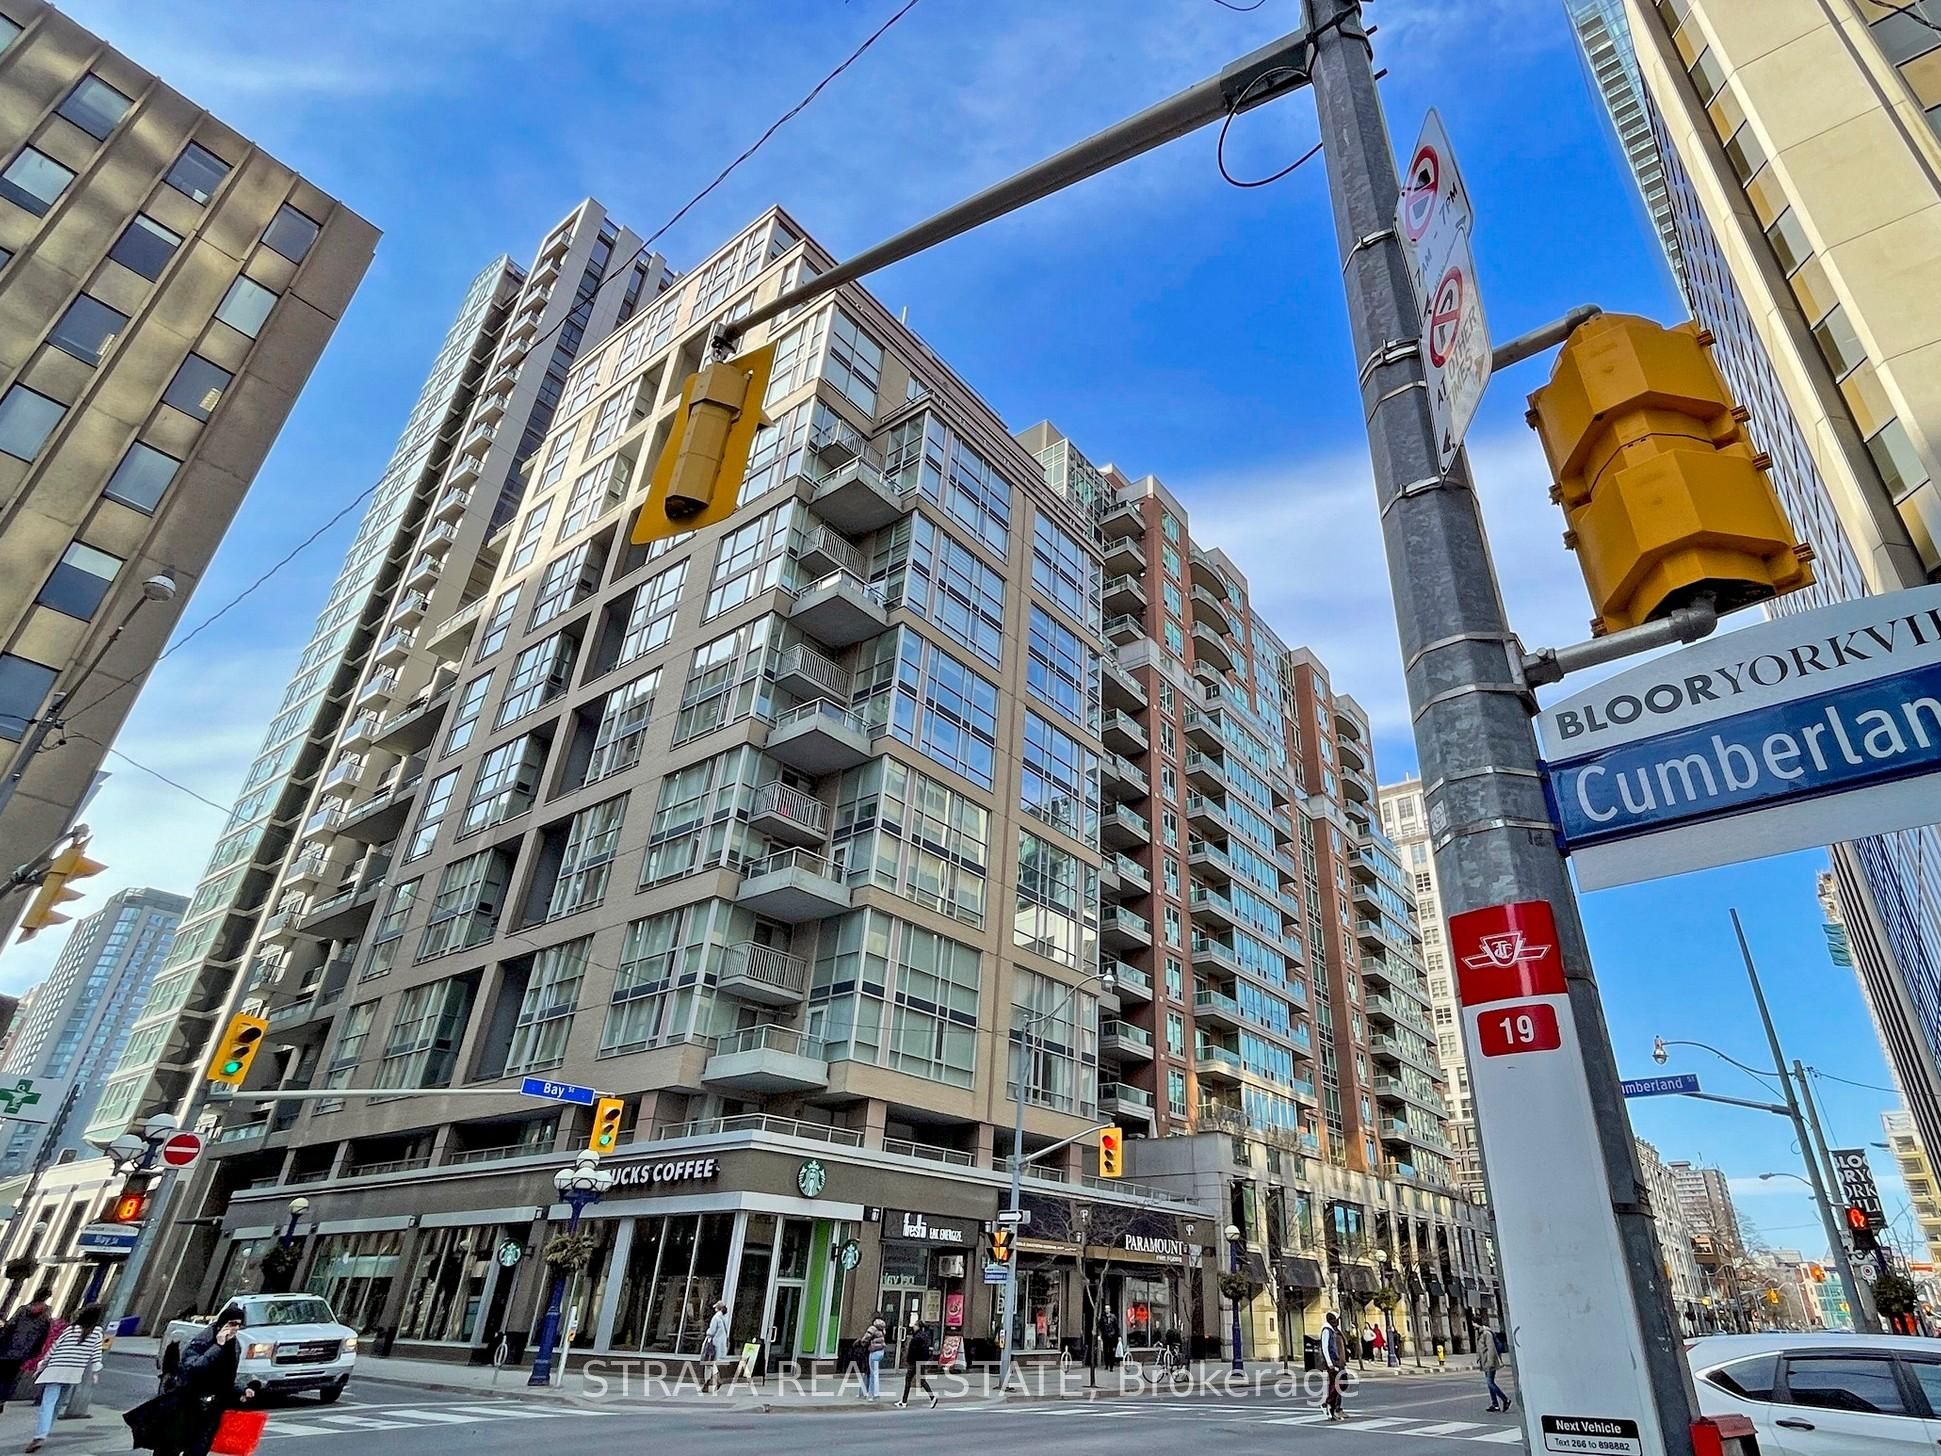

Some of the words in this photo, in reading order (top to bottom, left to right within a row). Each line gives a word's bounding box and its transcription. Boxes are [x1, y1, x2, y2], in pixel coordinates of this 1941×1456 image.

[1437, 375, 1447, 410] AT
[1448, 305, 1478, 378] OTHER
[1446, 349, 1474, 410] TIMES
[1499, 1014, 1535, 1045] 19
[543, 1082, 565, 1098] Bay
[611, 1165, 650, 1186] UCKS
[652, 1158, 715, 1182] COFFEE
[1125, 1233, 1184, 1256] PARAMOUNT
[1555, 1419, 1580, 1431] Next
[1581, 1421, 1622, 1434] Vehicle
[1554, 1438, 1570, 1447] Text
[1588, 1440, 1597, 1449] to
